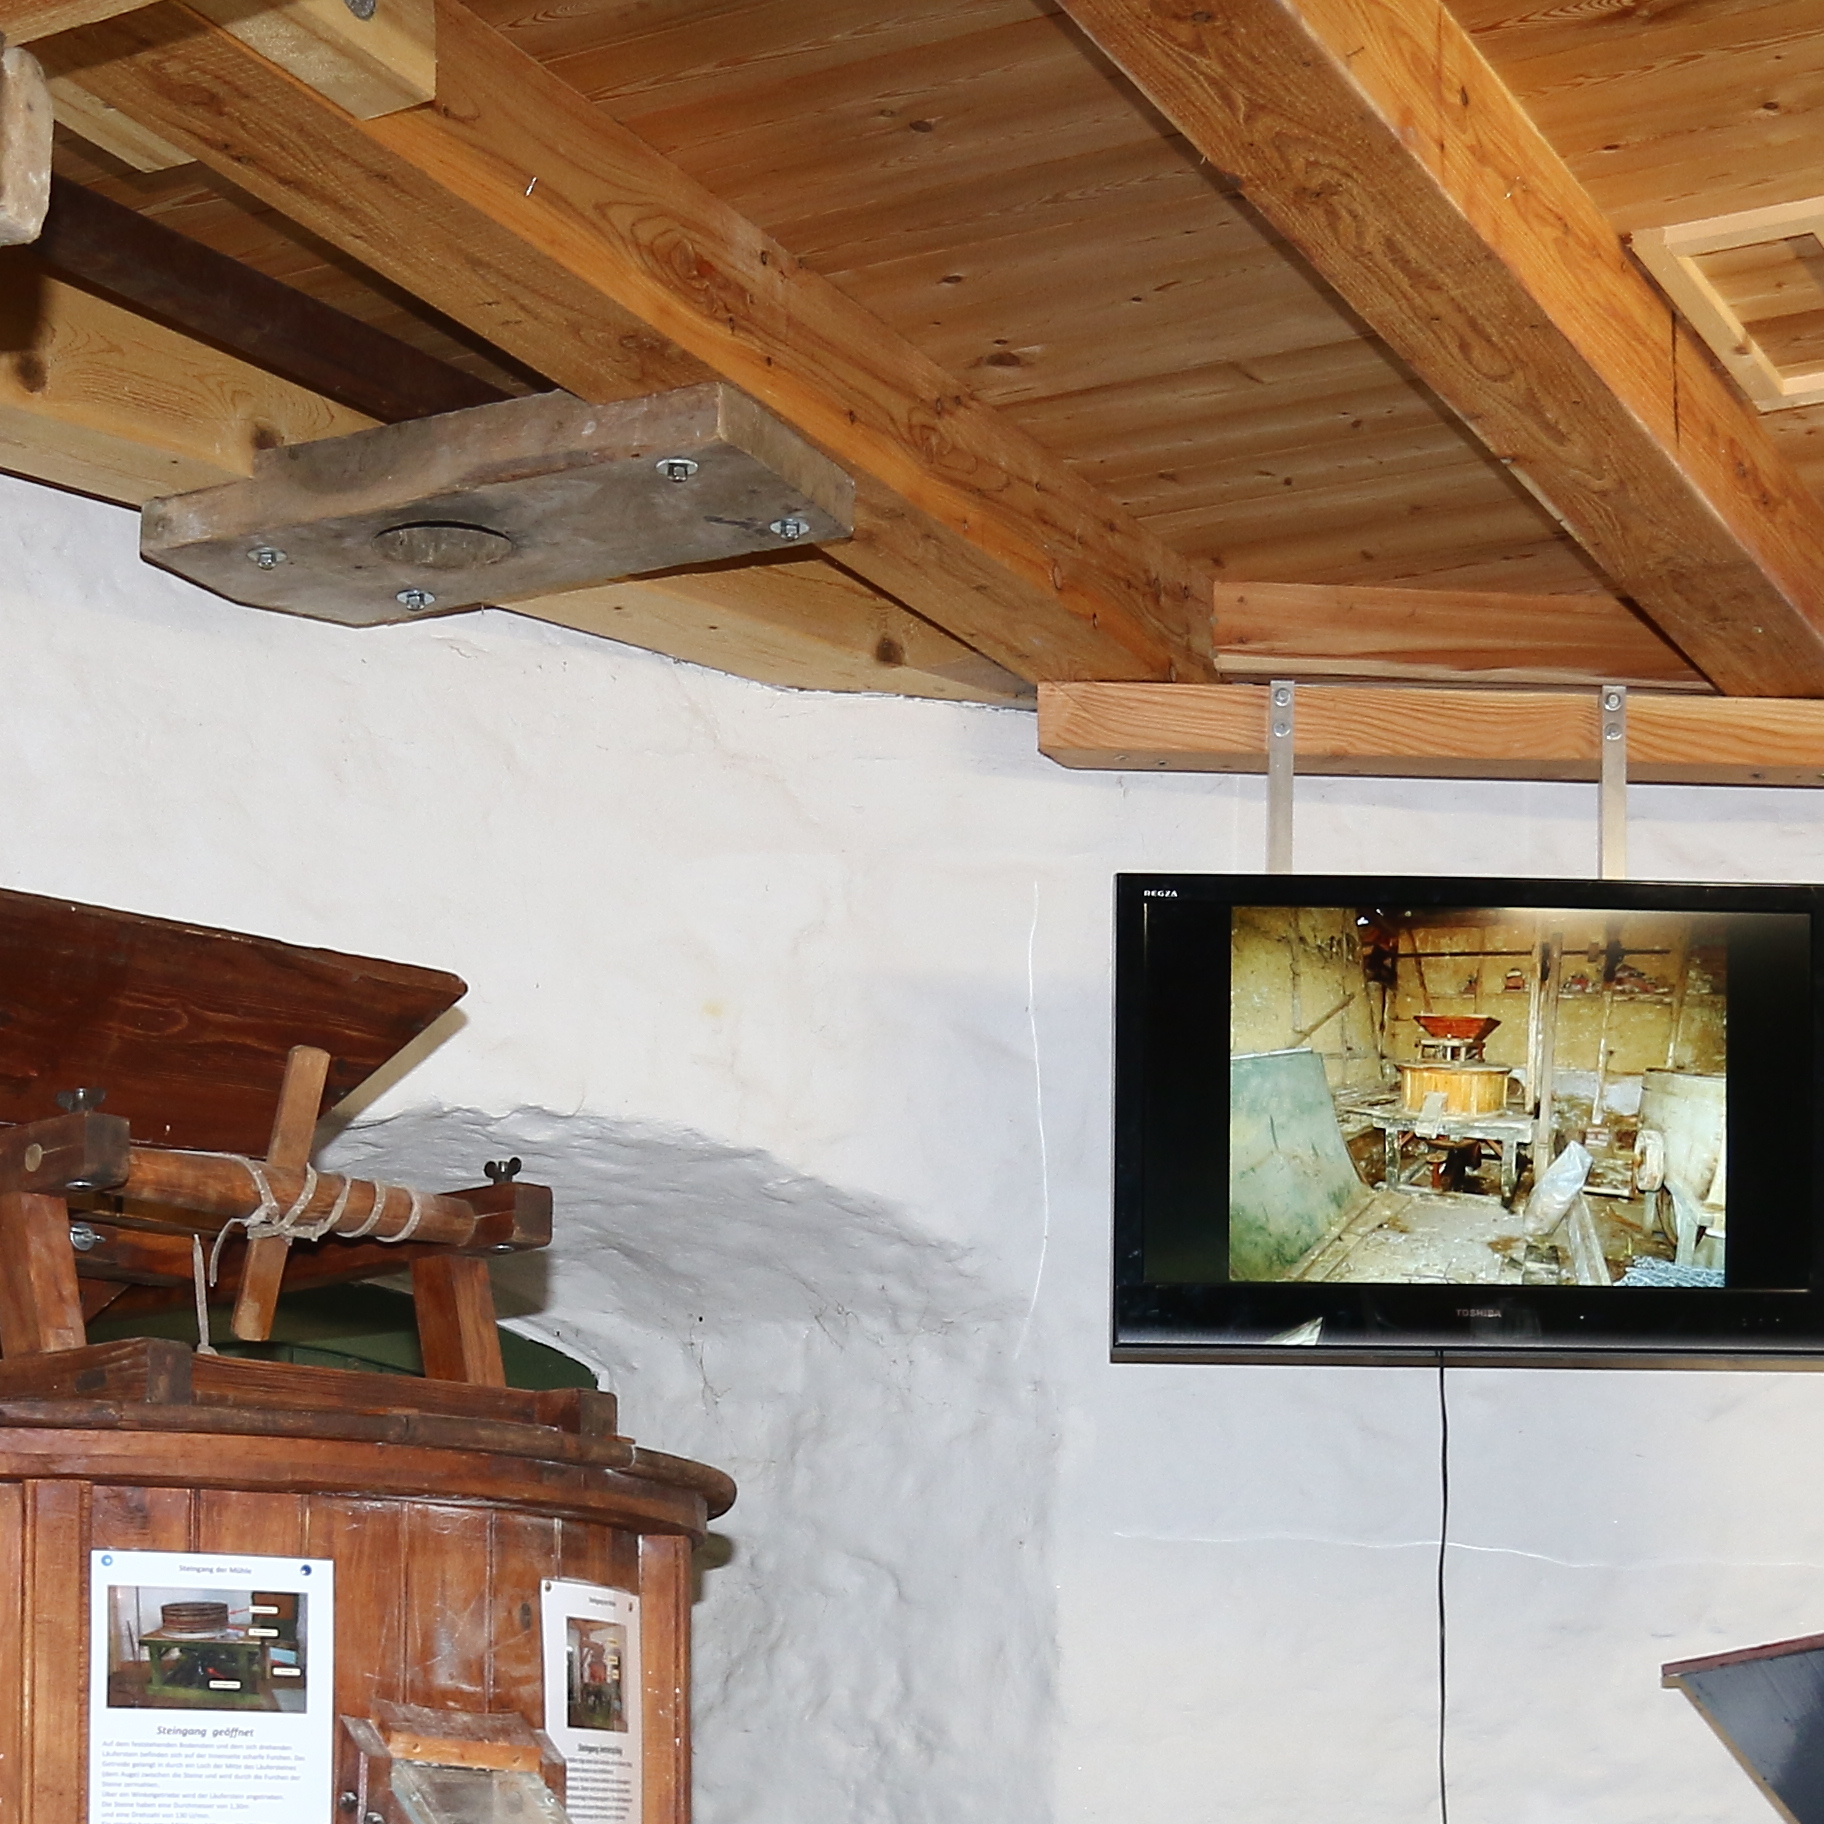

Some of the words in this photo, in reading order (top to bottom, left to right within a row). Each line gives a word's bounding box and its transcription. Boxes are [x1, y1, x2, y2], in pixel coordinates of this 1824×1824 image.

[1143, 889, 1179, 898] REGZA
[1456, 1308, 1503, 1319] TOSHIBA
[178, 1564, 214, 1575] Steingang
[215, 1565, 228, 1574] der
[229, 1566, 253, 1575] Mühle
[156, 1724, 208, 1738] Steingang
[211, 1726, 255, 1739] geöffnet
